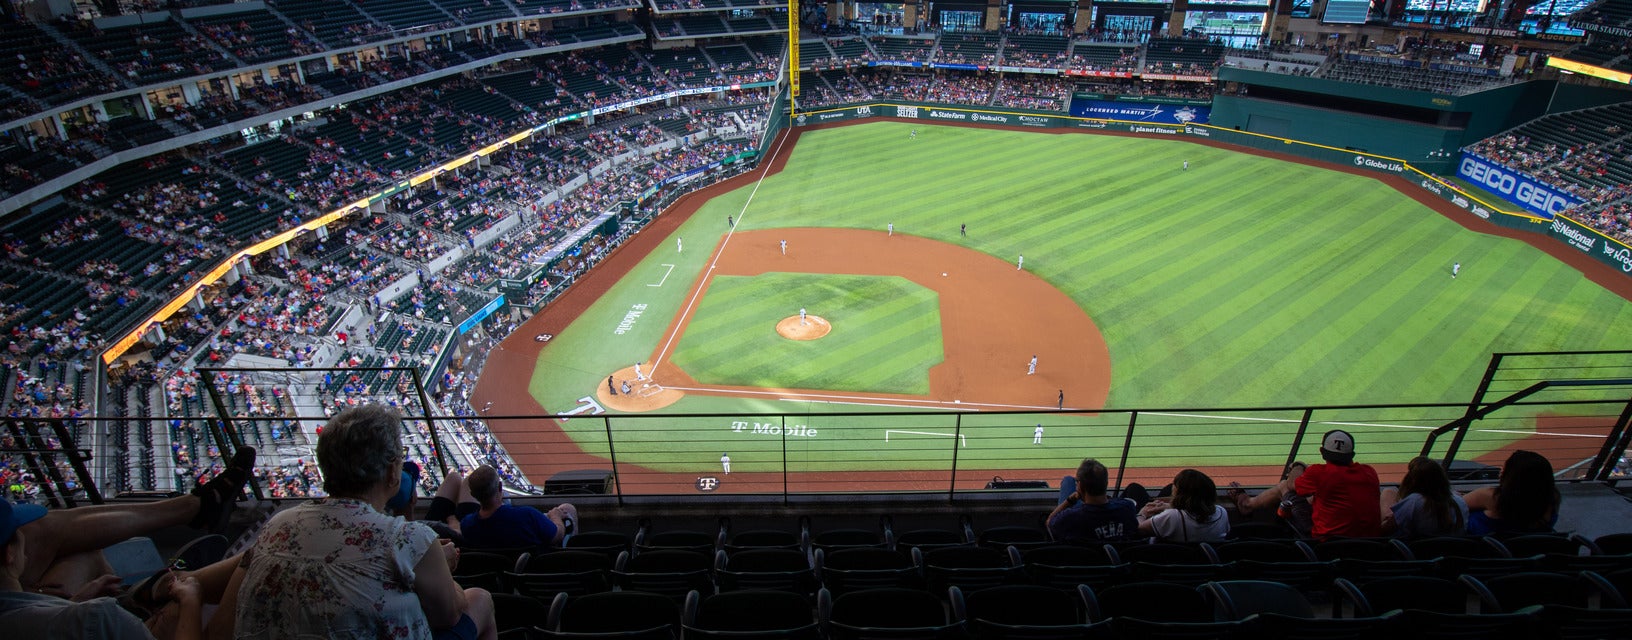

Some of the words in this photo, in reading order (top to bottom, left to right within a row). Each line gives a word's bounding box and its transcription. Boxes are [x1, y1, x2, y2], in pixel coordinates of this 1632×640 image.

[1467, 27, 1491, 36] HART
[1491, 29, 1517, 37] HVAC
[1576, 21, 1598, 33] LUXOR
[1599, 25, 1632, 39] STAFFING
[857, 105, 871, 114] UTA
[897, 110, 918, 118] SELTZER
[1086, 106, 1119, 114] LOCKHEED
[1021, 115, 1048, 123] CHOCTAW
[1135, 126, 1155, 134] planet
[1155, 126, 1177, 135] fitness
[1365, 159, 1387, 170] Globe
[1388, 163, 1403, 173] Life
[1460, 157, 1516, 194] GEICO
[1560, 223, 1596, 247] National
[1576, 242, 1591, 252] Rental
[614, 310, 643, 335] Mobile
[752, 422, 818, 438] Mobile
[1334, 440, 1344, 451] T
